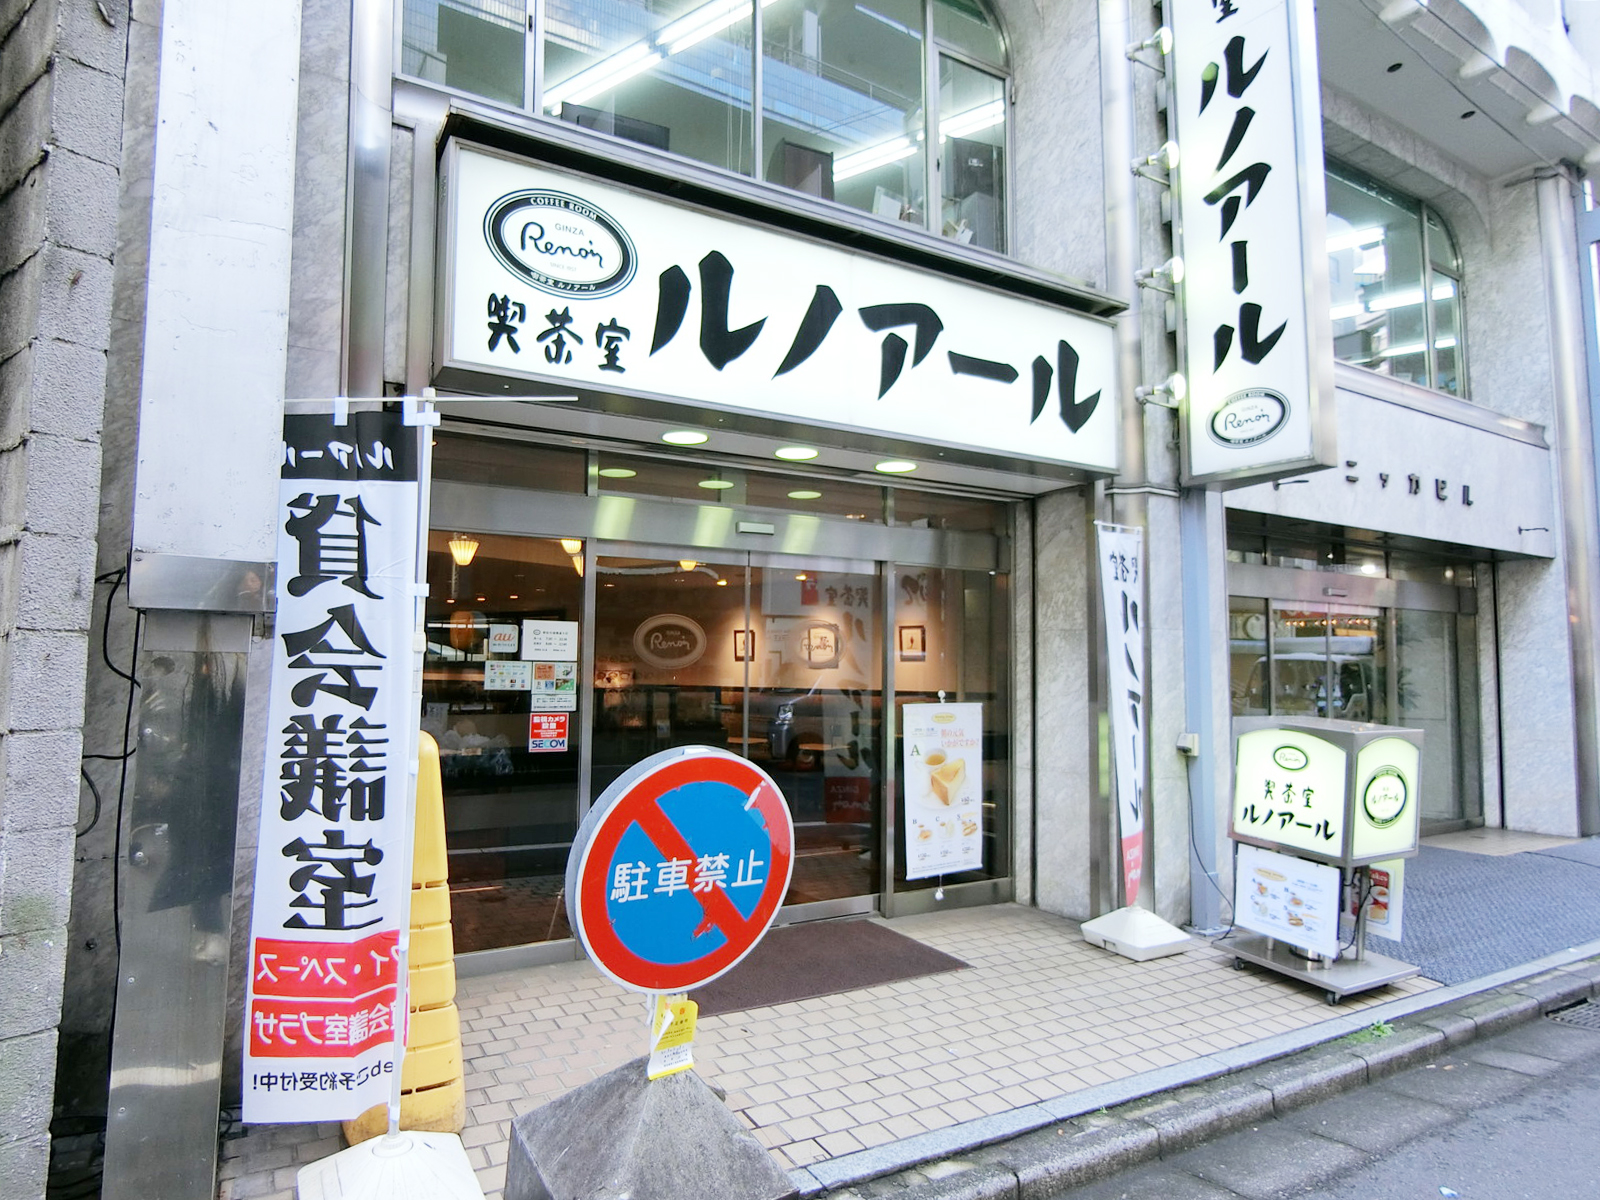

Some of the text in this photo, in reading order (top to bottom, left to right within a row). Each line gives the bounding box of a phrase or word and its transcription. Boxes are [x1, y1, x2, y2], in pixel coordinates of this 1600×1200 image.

[530, 197, 598, 221] COFFEE ROOM
[1198, 36, 1288, 375] ルノアール
[554, 223, 585, 236] GINZA
[520, 221, 604, 269] Renoir
[487, 250, 1101, 435] 喫茶室 ルノアール
[1224, 408, 1270, 431] Renoir
[494, 633, 514, 641] au
[650, 632, 691, 650] Renoir
[532, 739, 565, 748] SECOM
[910, 744, 921, 757] A
[1264, 779, 1315, 809] 喫茶室
[1242, 803, 1335, 840] ルノアール
[610, 849, 764, 903] 駐車禁止
